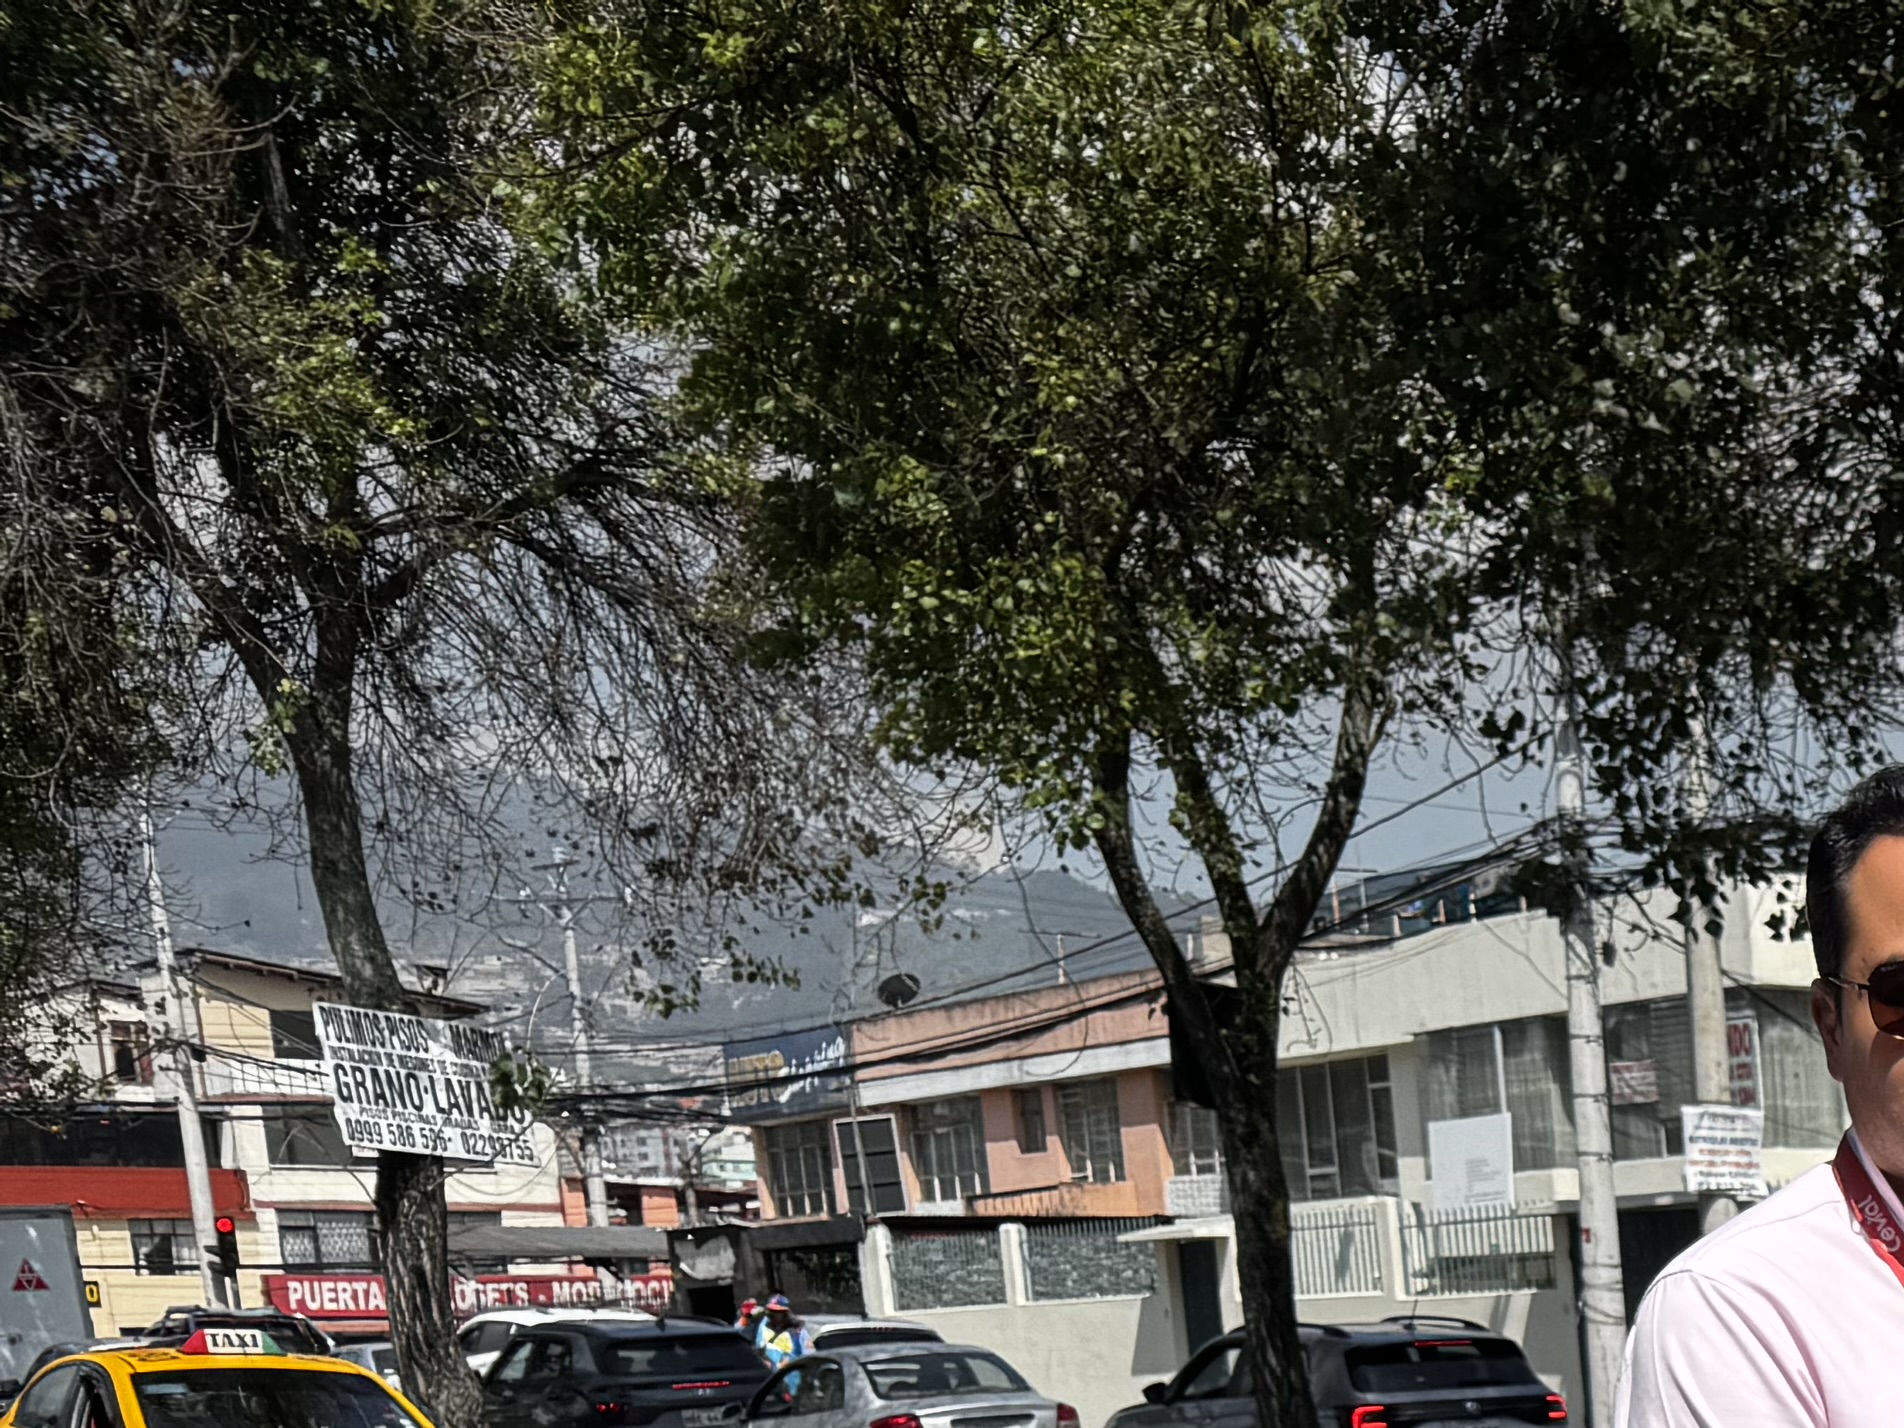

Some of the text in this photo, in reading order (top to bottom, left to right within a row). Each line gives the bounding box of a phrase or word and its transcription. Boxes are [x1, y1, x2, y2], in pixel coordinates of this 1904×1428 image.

[333, 1063, 424, 1113] GRANO
[346, 1118, 384, 1144] 0999
[1858, 1194, 1901, 1252] Cevial
[287, 1281, 386, 1310] PUERTA
[205, 1333, 260, 1348] TAXI
